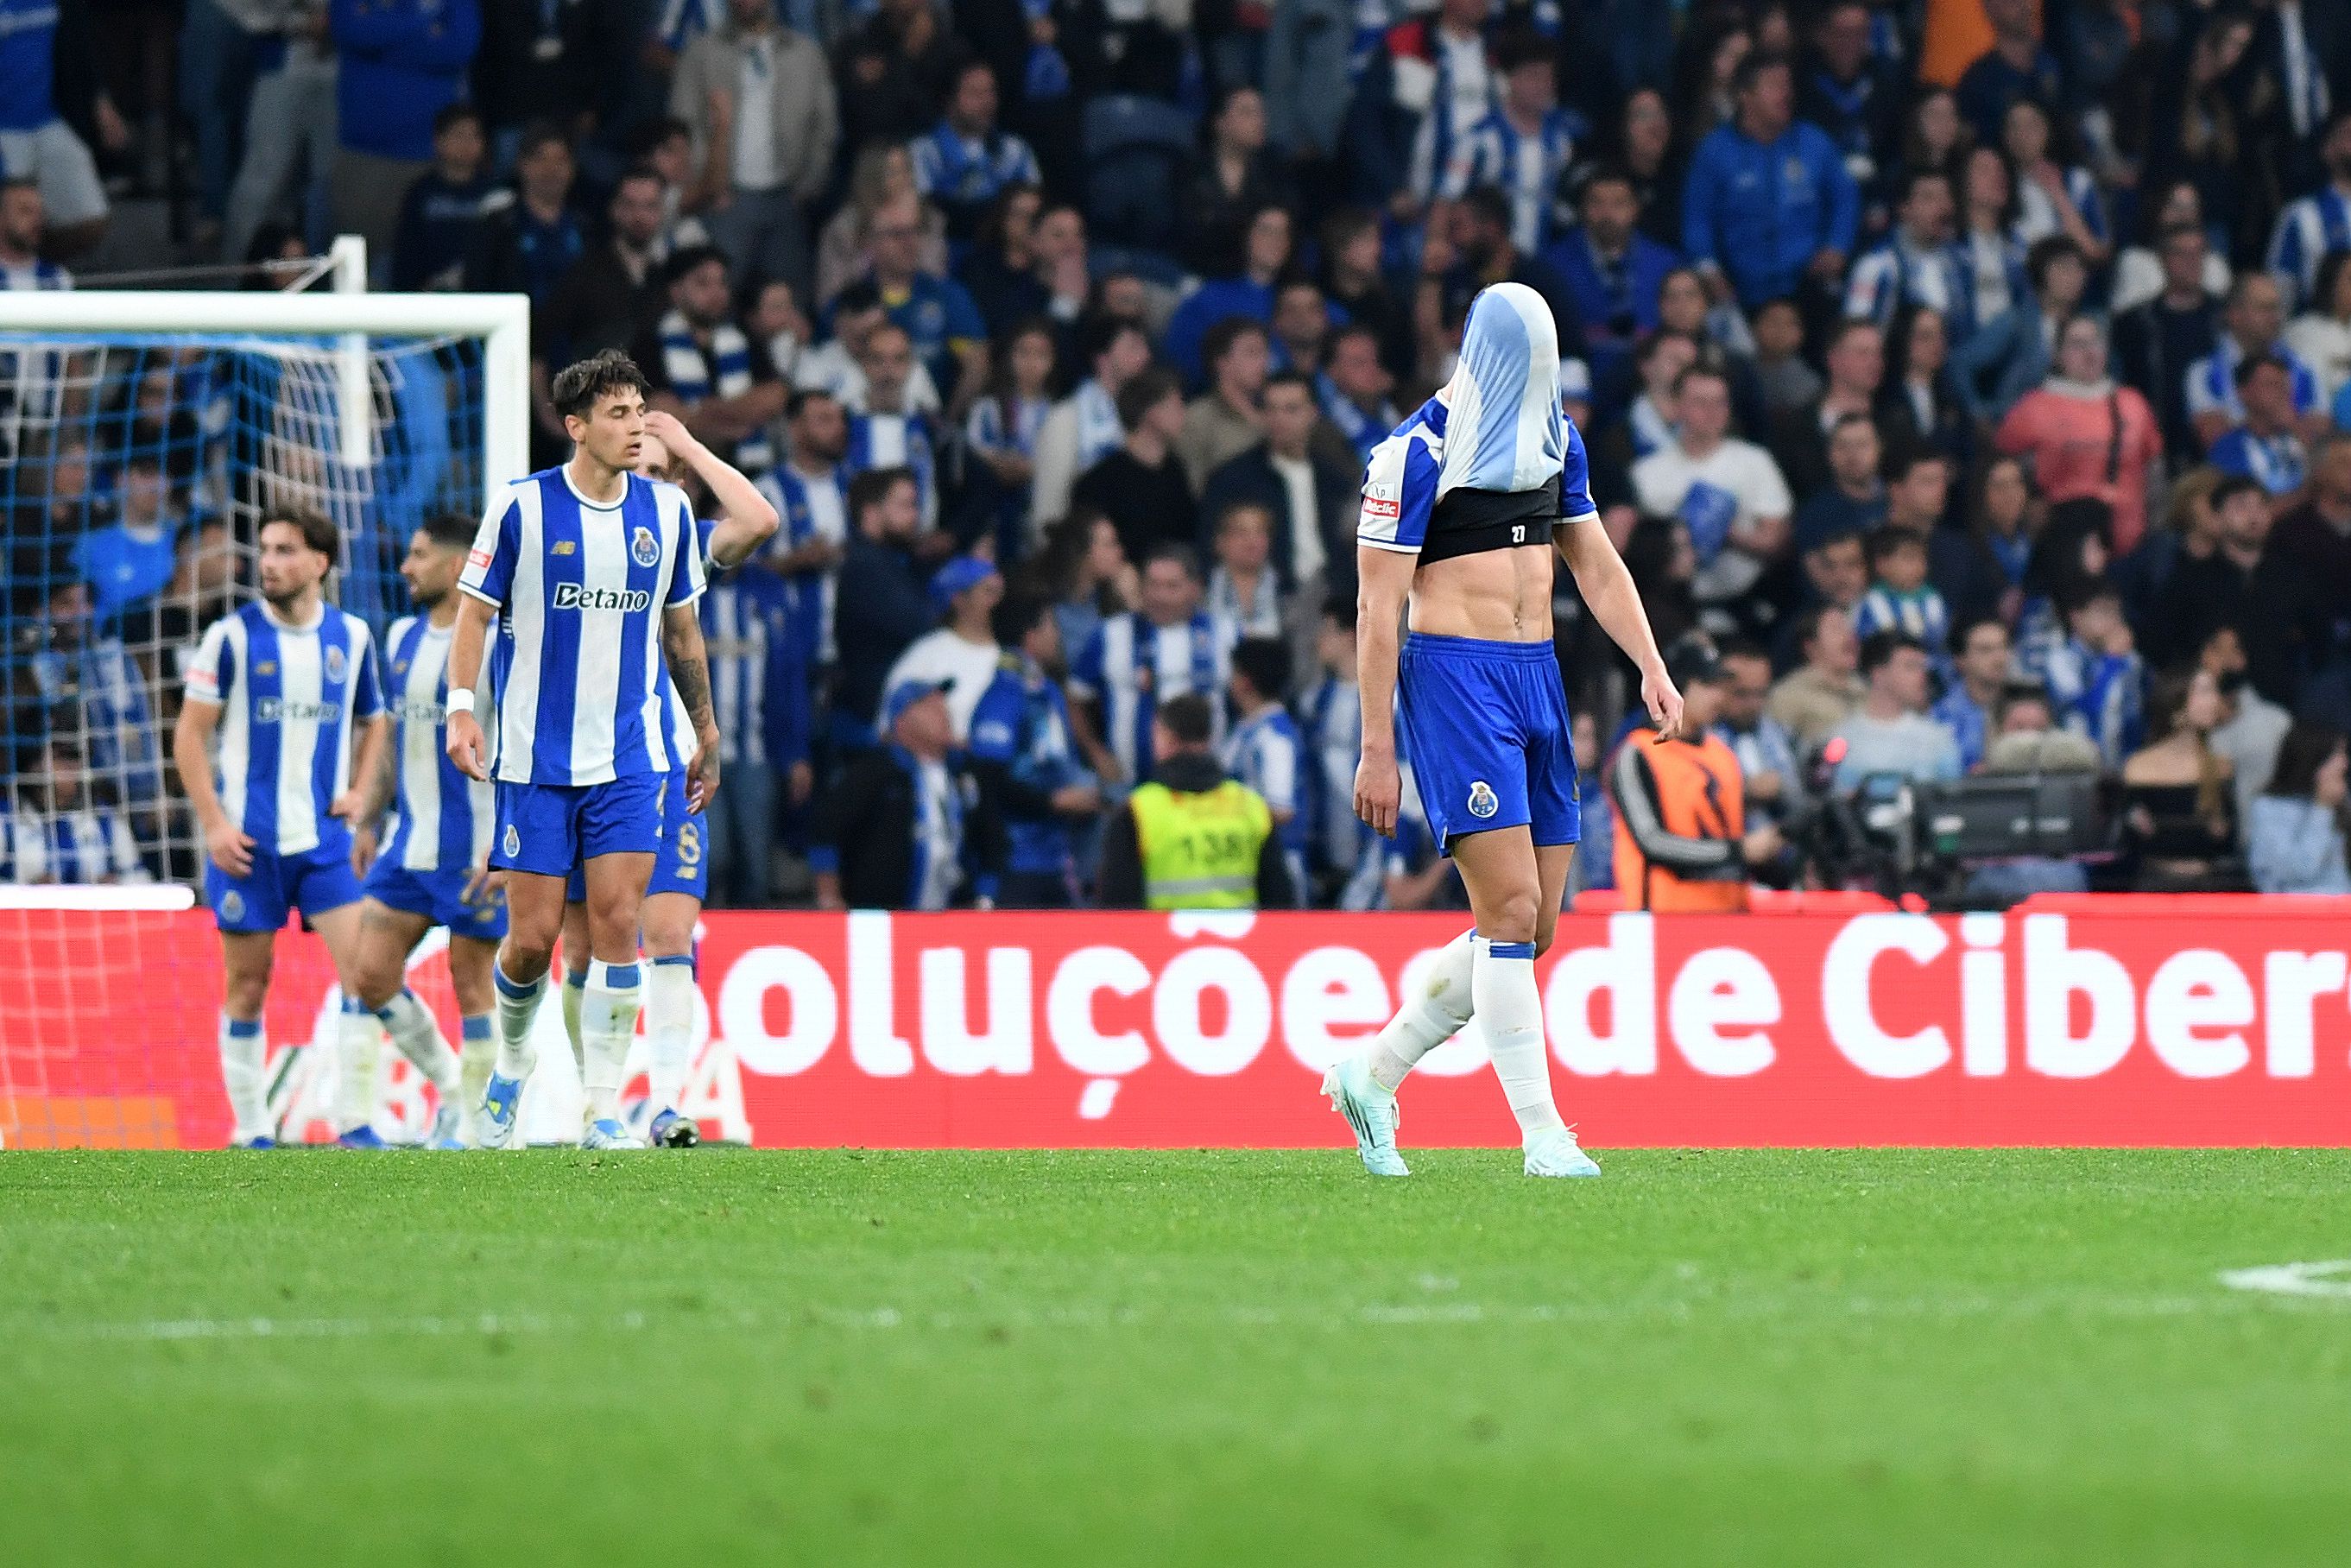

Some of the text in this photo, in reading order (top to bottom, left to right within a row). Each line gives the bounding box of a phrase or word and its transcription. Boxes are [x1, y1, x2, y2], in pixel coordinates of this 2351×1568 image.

[1511, 525, 1526, 543] 27
[553, 582, 650, 612] Betano
[677, 821, 701, 864] 8
[1544, 912, 1781, 1078] de
[1822, 912, 2351, 1078] Ciber
